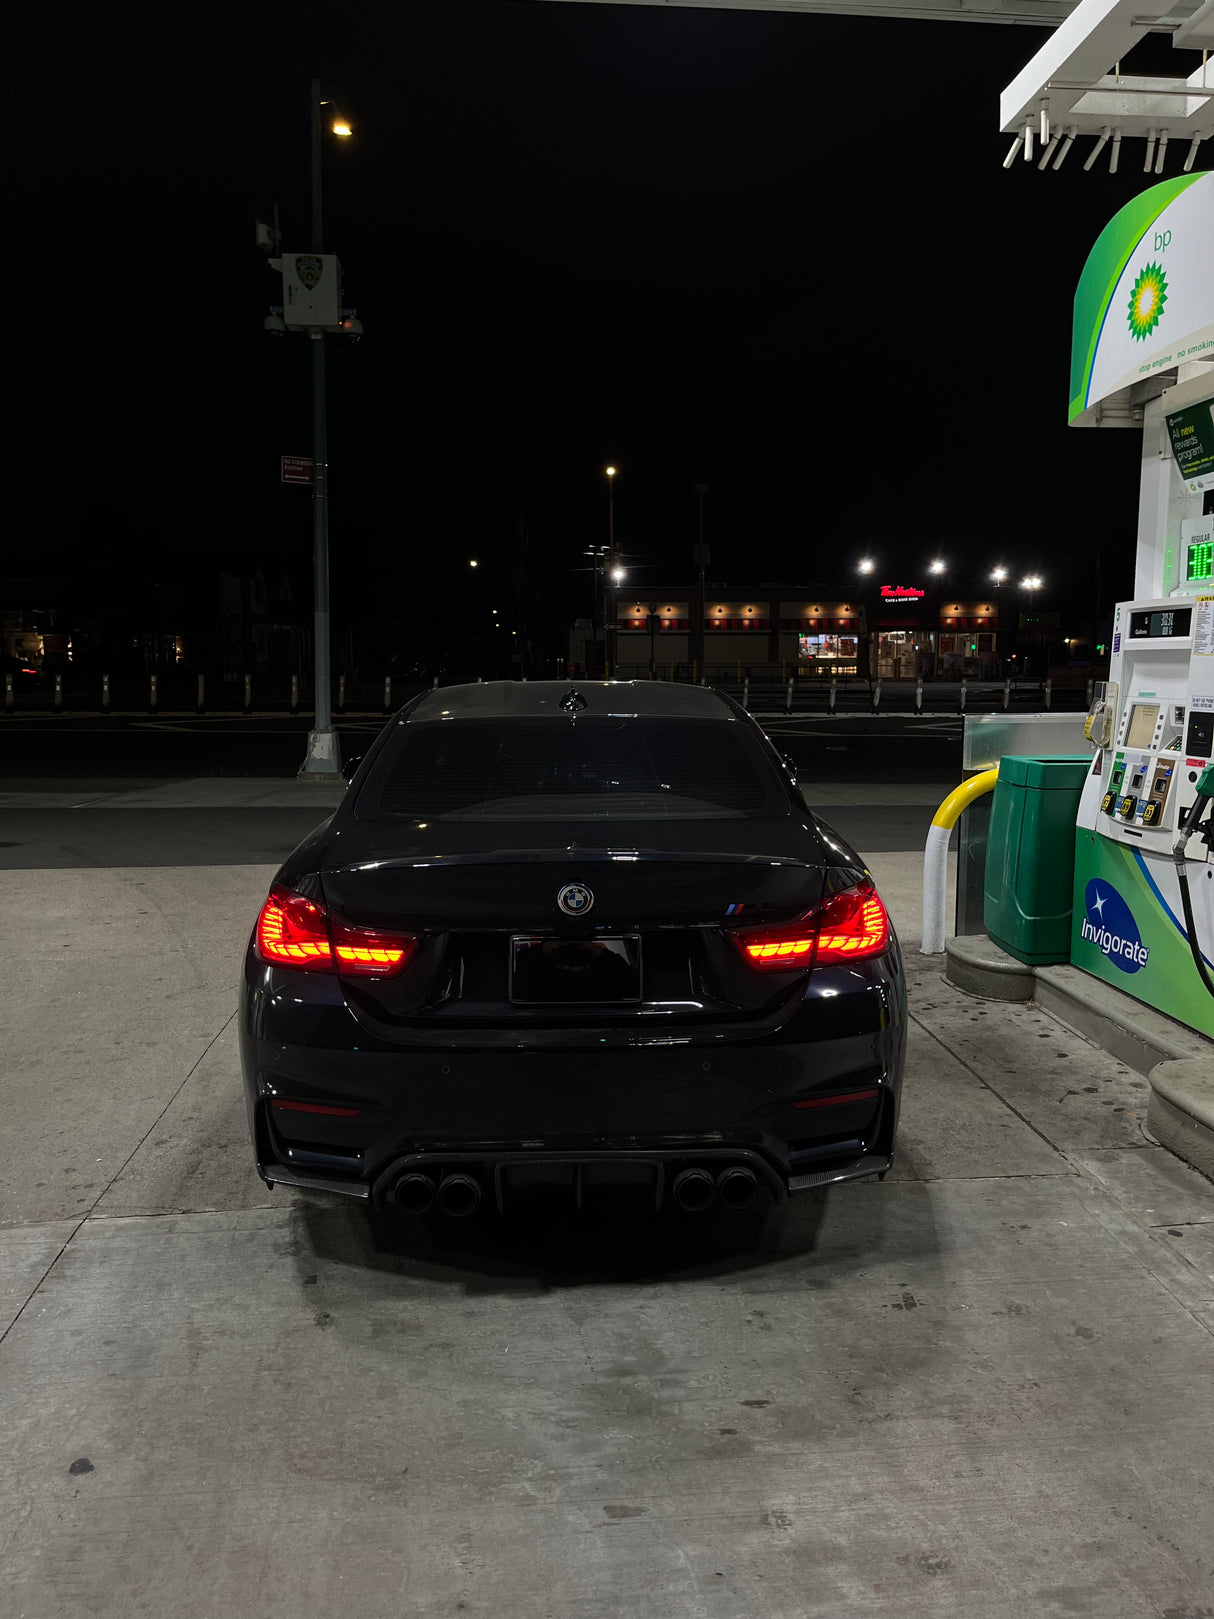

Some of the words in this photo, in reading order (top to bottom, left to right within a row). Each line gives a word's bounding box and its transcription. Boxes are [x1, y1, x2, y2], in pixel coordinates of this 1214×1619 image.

[1154, 230, 1171, 253] bp
[1138, 364, 1151, 373] stop
[1152, 355, 1172, 367] engine
[1177, 350, 1186, 358] no
[1172, 428, 1180, 440] All
[1180, 425, 1195, 437] new
[1174, 434, 1198, 450] rewards
[1177, 443, 1204, 462] program!
[1191, 533, 1210, 543] REGULAR
[880, 585, 894, 596] Tim
[894, 586, 924, 597] Hortons
[1116, 607, 1121, 622] 5
[1081, 917, 1147, 966] Invigorate
